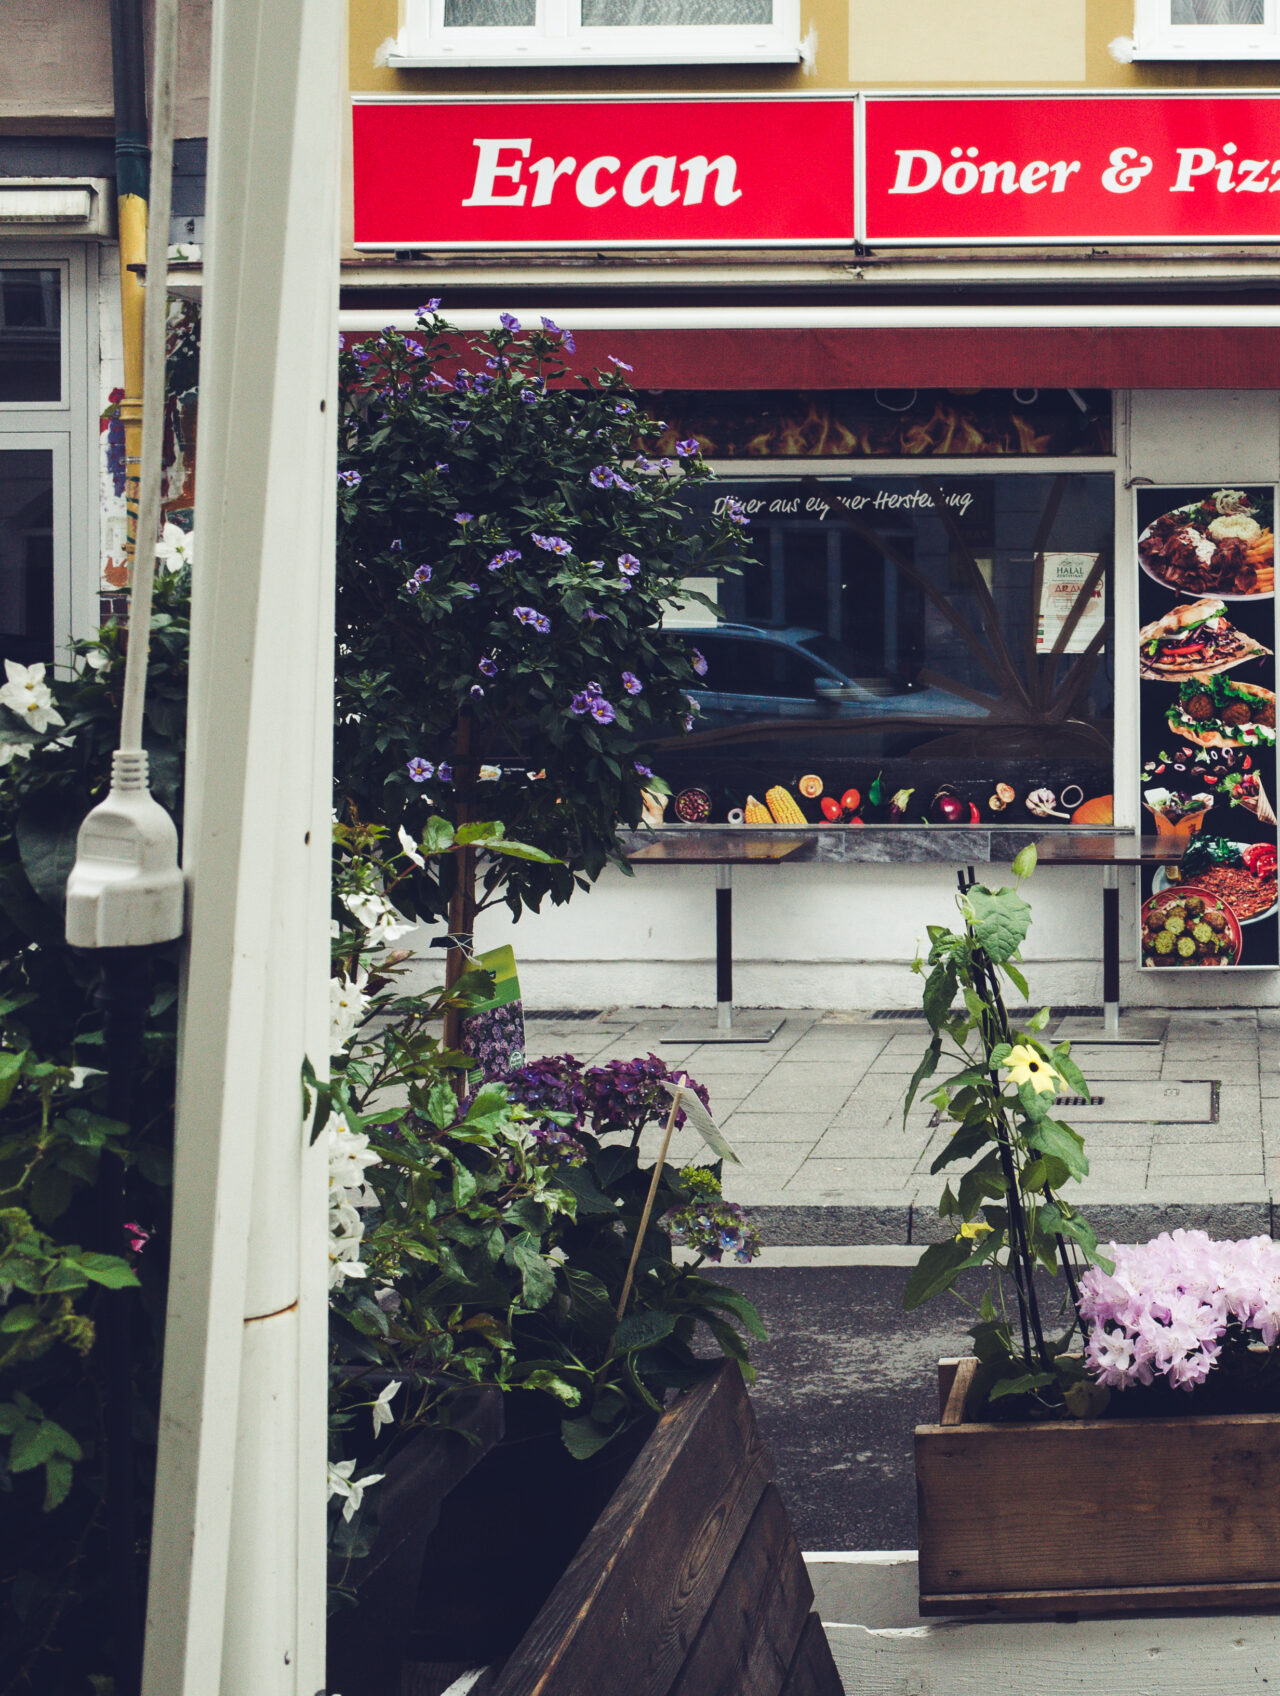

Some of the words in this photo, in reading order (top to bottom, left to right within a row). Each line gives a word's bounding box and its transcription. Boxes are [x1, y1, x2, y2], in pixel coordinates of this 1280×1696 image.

[461, 137, 743, 208] Ercan
[887, 146, 1082, 195] Döner
[1101, 146, 1154, 194] &
[768, 498, 800, 513] aus
[805, 495, 871, 520] eigner
[1056, 566, 1084, 575] HALAL
